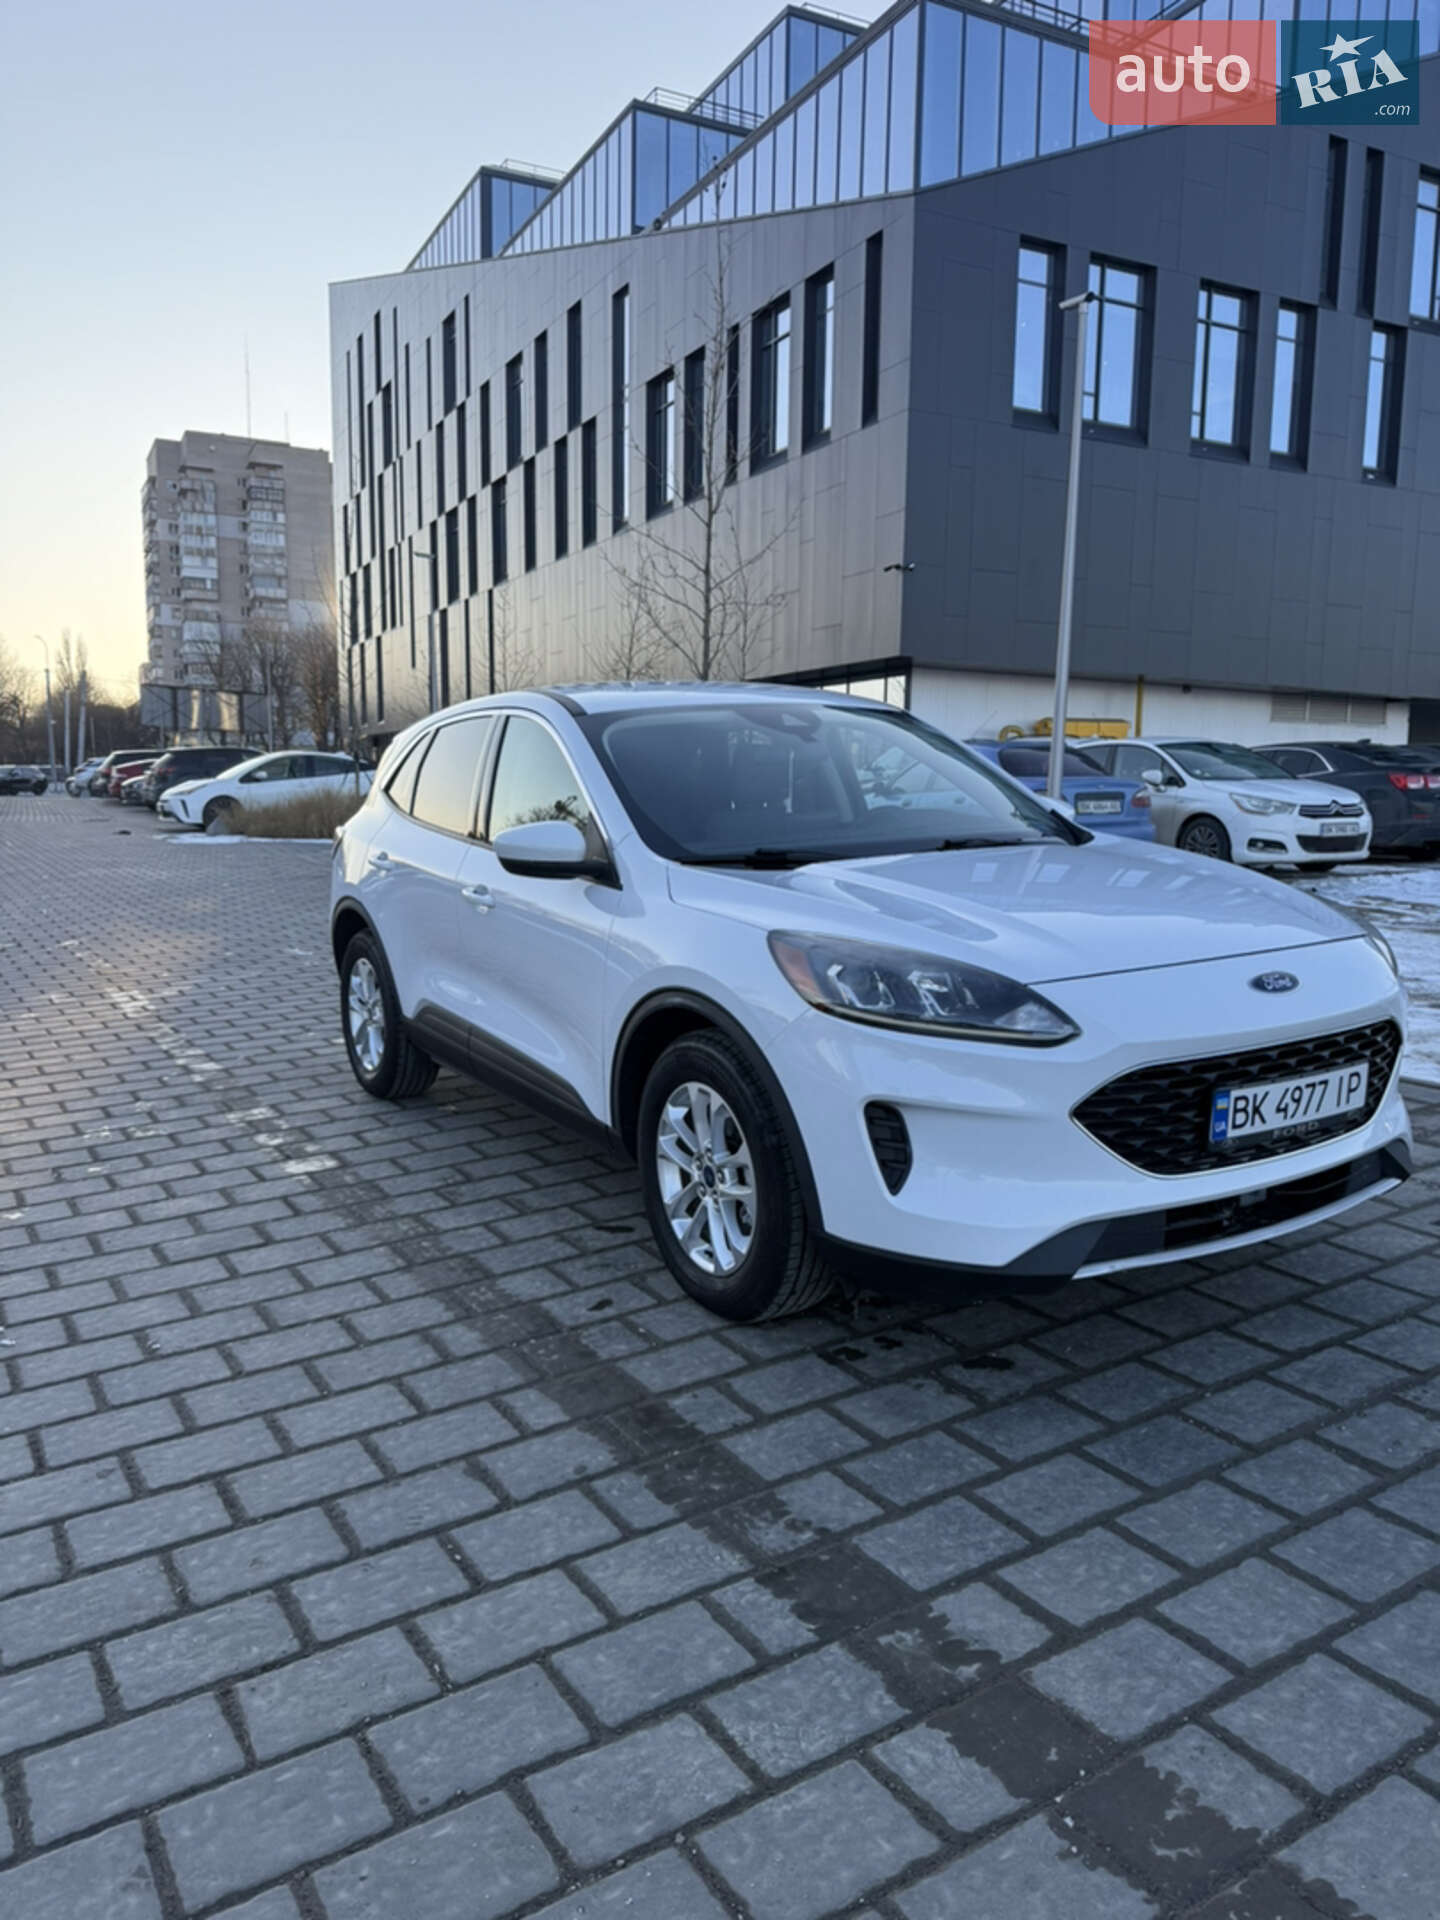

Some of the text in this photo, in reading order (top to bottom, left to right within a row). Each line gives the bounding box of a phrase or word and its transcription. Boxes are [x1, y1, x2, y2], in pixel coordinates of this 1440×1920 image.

[1231, 1071, 1361, 1130] BK 4977 IP
